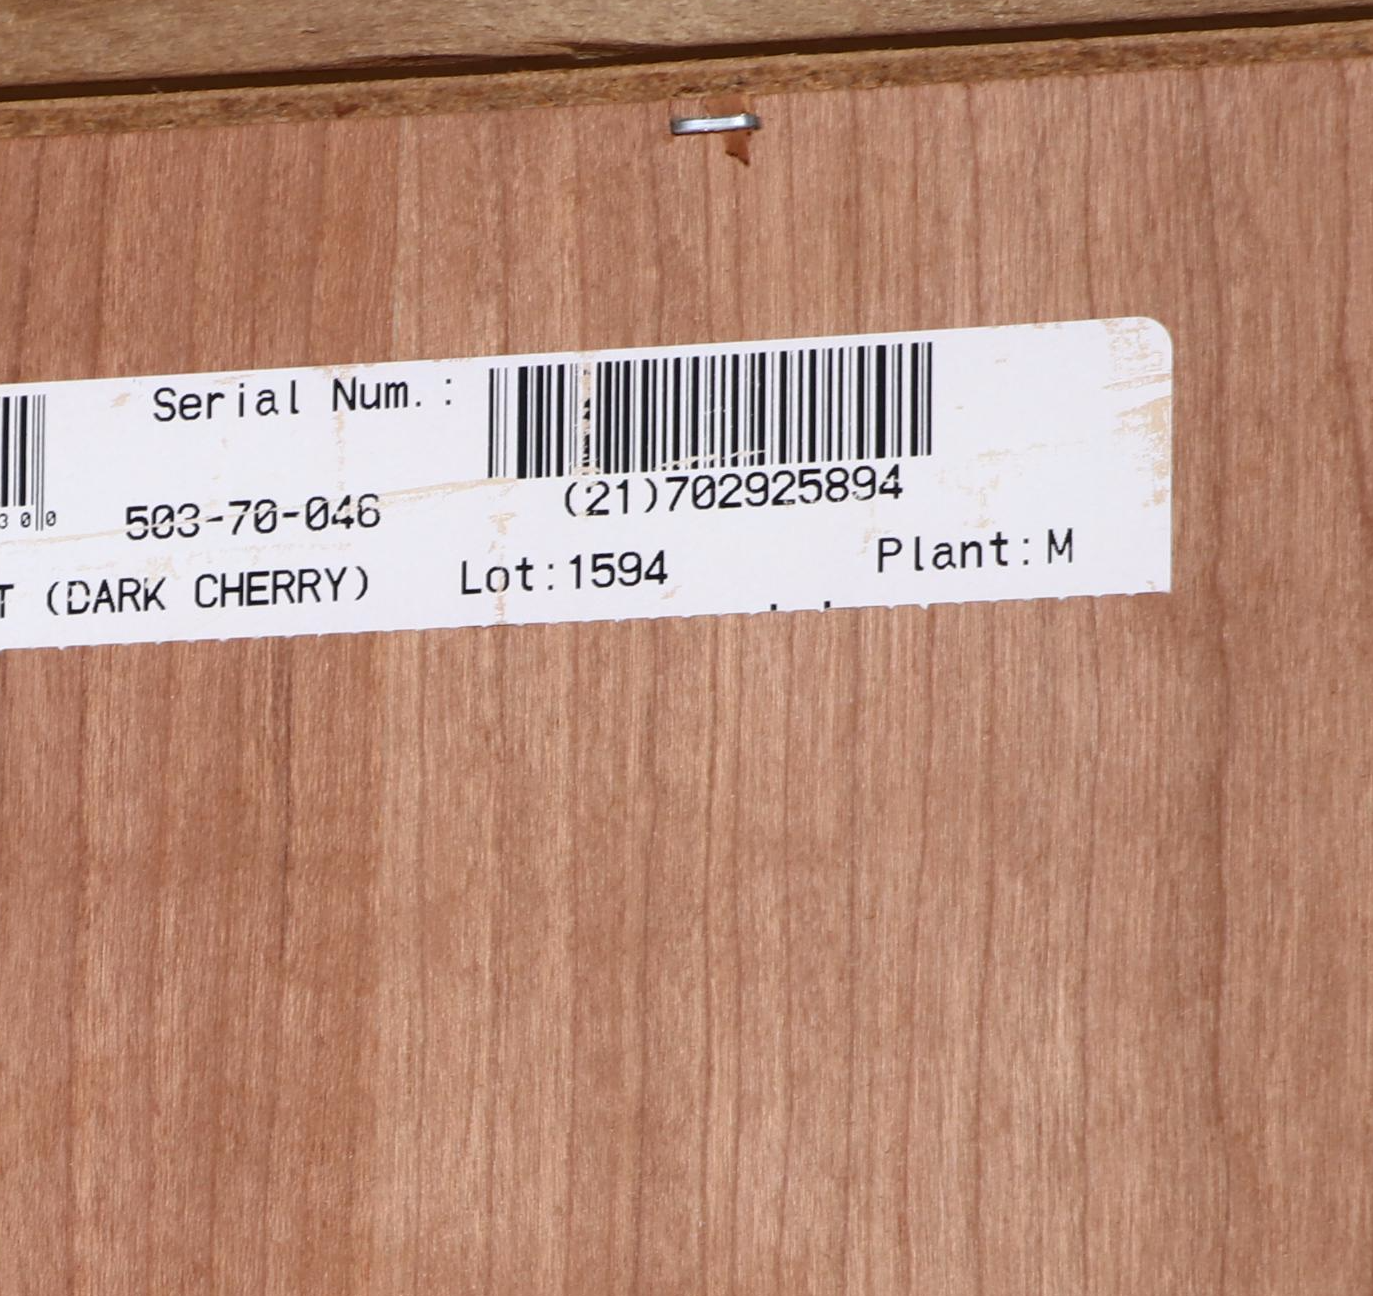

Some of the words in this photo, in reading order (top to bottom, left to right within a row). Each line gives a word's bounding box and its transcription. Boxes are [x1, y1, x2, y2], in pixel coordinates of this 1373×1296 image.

[154, 380, 299, 421] Serial
[564, 463, 903, 517] (21)702925894
[126, 494, 380, 540] 503-70-046
[47, 578, 165, 615] (DARK
[195, 566, 368, 608] CHERRY)
